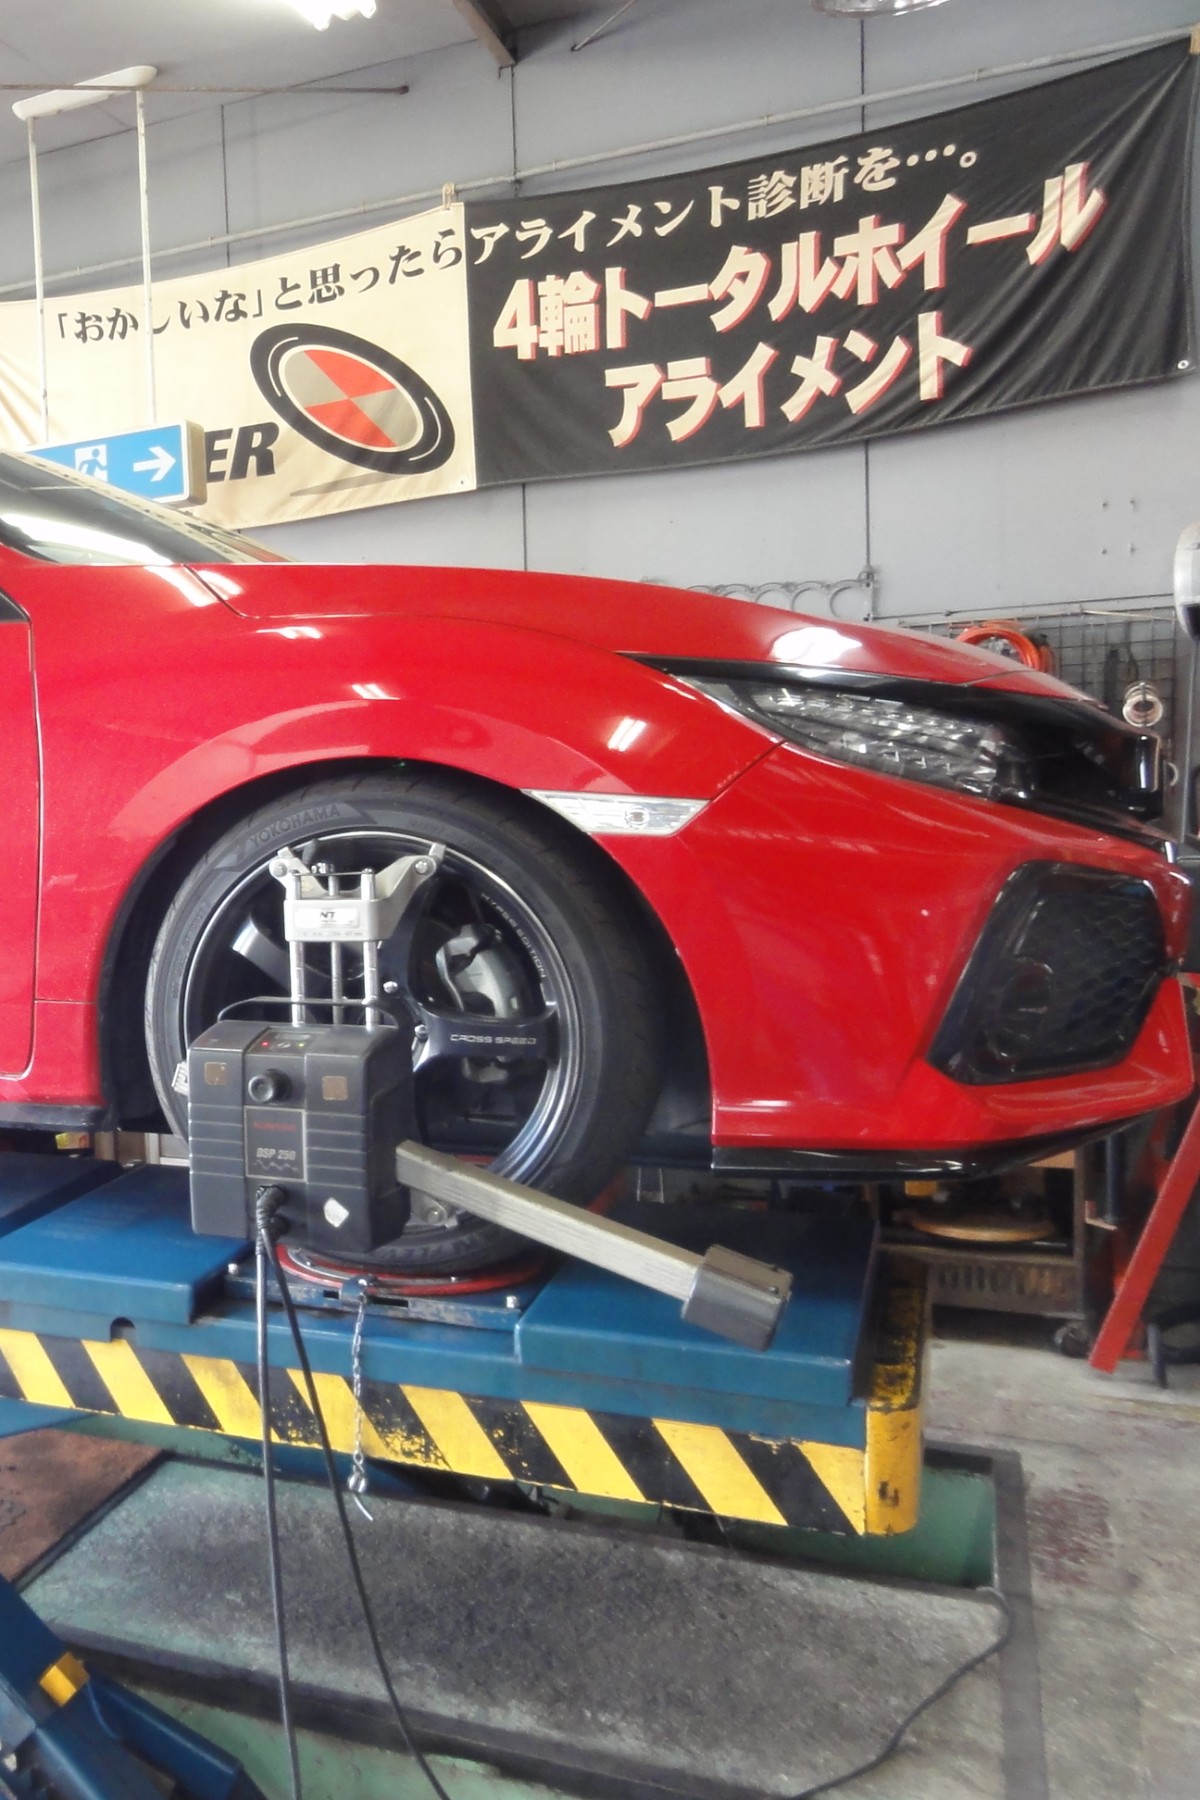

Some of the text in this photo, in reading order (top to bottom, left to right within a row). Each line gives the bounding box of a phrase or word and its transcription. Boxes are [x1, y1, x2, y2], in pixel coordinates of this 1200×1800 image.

[492, 161, 1107, 361] 4輪トータルホイール
[604, 311, 975, 447] アライメント
[250, 803, 341, 848] YOKOHAMA
[450, 1034, 537, 1045] CROSS SPEED
